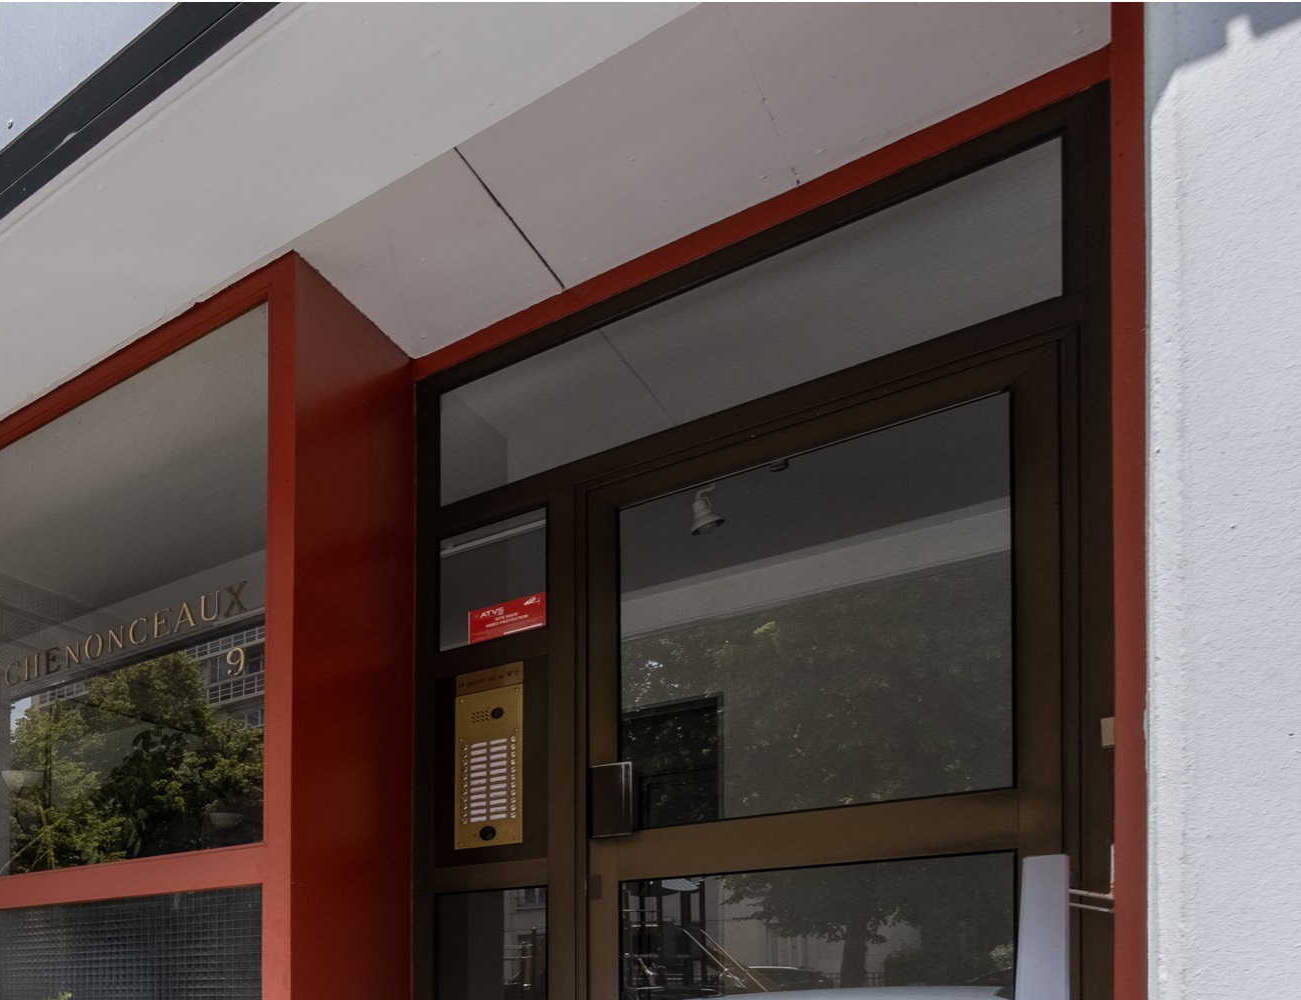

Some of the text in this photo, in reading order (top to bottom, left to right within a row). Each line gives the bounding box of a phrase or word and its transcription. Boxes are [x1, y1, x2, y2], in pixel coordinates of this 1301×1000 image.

[480, 607, 504, 619] ATVS
[4, 580, 247, 687] CHENONCEAUX
[226, 646, 246, 676] 9
